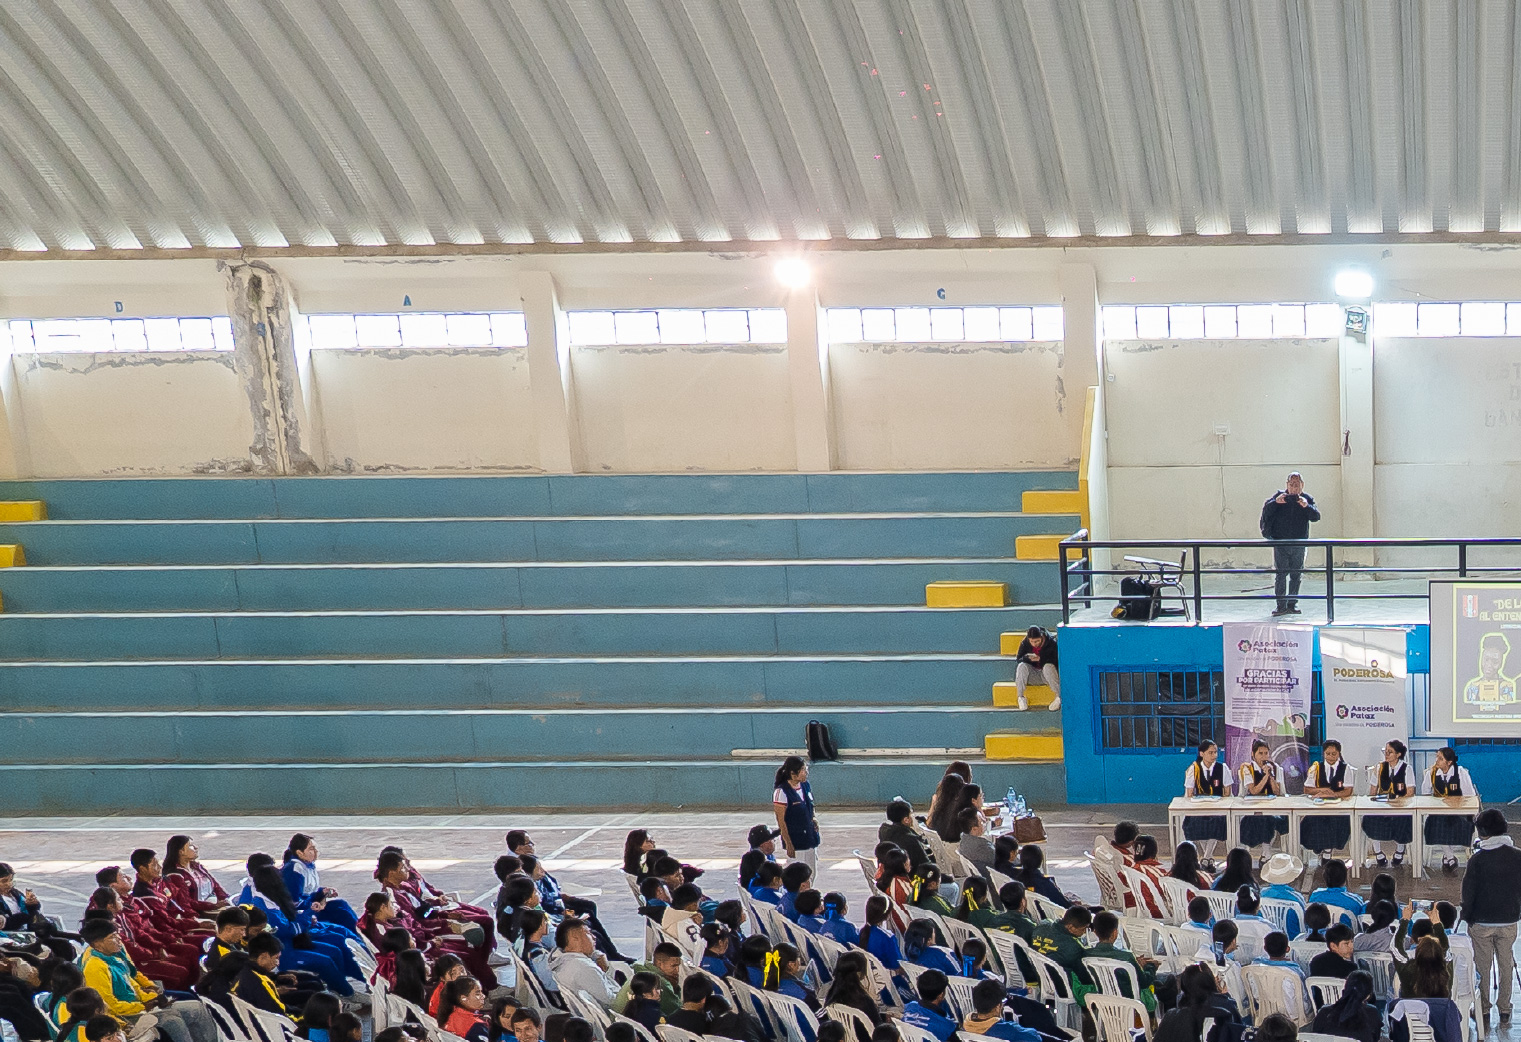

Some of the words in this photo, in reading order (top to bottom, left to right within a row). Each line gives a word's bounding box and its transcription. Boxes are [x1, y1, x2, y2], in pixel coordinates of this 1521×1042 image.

[1246, 669, 1288, 678] GRACIAS
[1333, 667, 1395, 679] PODEROSA
[1350, 704, 1395, 713] Asociación
